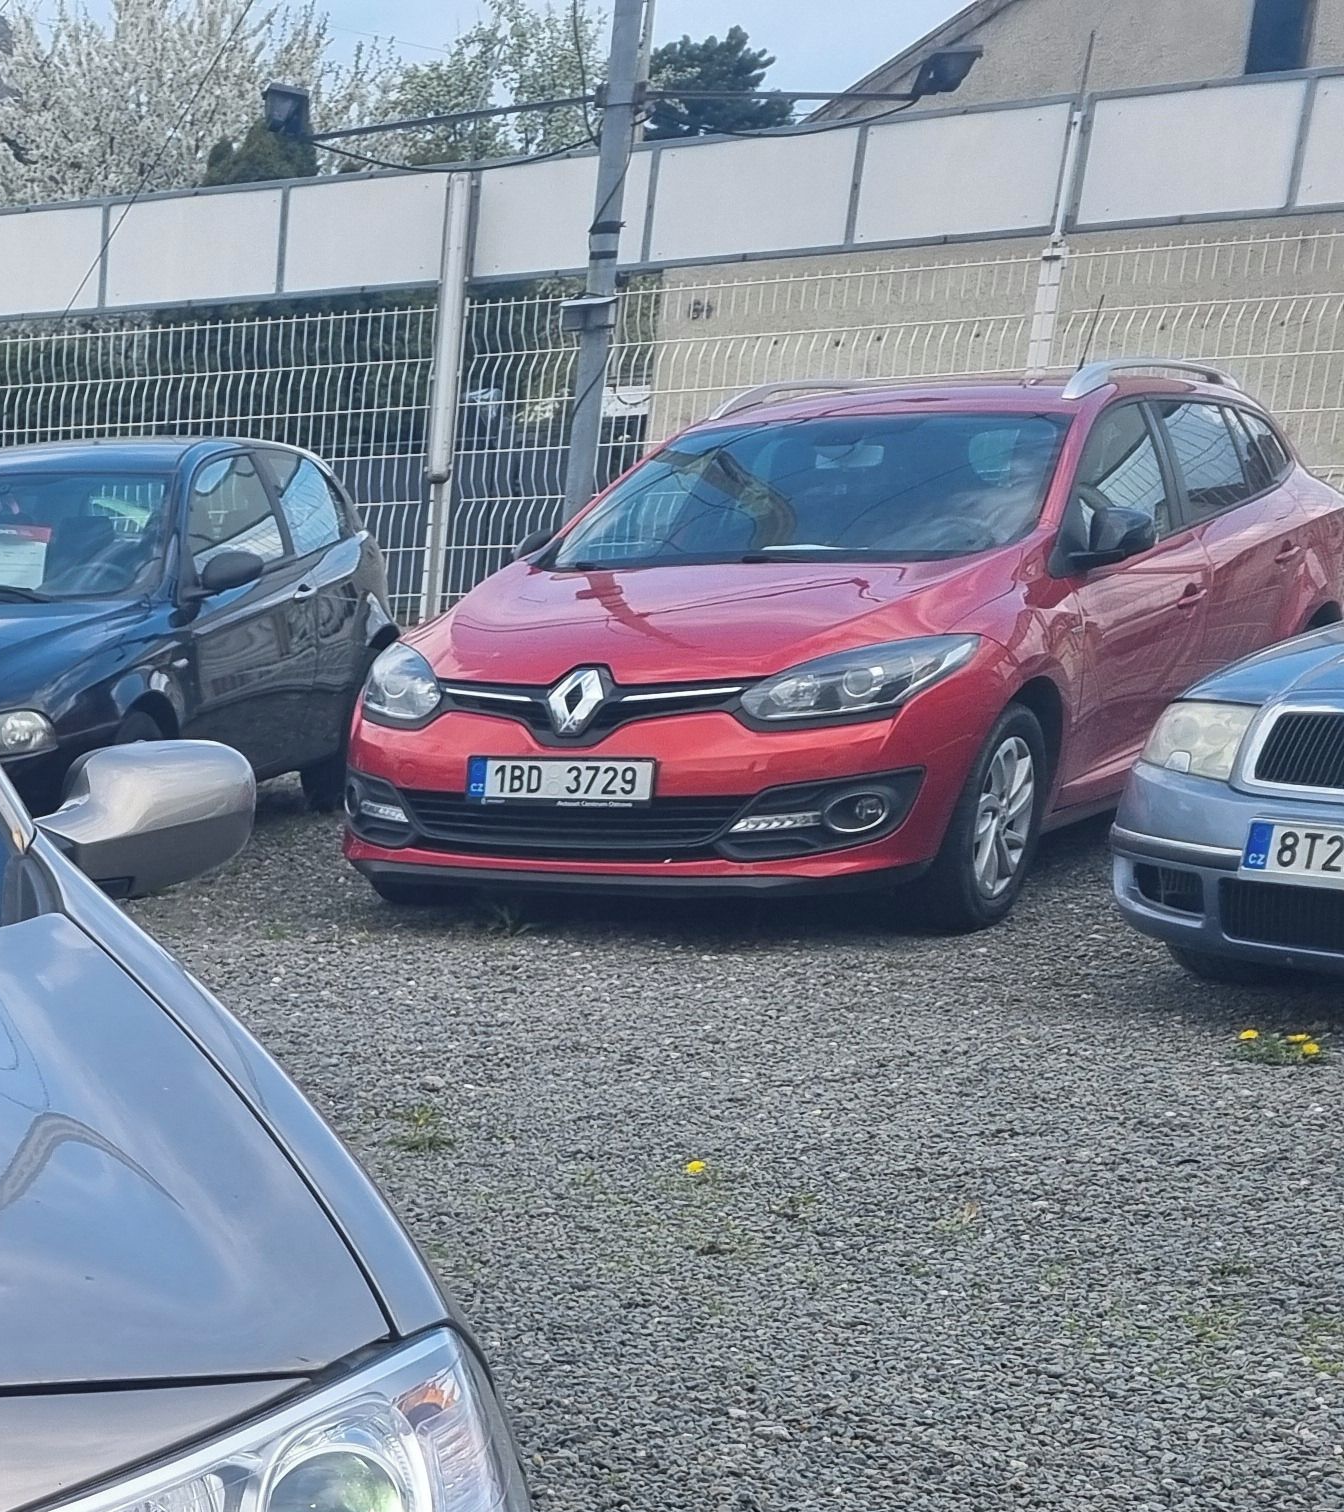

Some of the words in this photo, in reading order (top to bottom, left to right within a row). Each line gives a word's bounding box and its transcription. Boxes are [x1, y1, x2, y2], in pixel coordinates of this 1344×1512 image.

[470, 783, 483, 792] CZ
[495, 764, 542, 793] 1BD
[565, 765, 637, 795] 3729
[1248, 852, 1265, 865] CZ
[1276, 831, 1344, 872] 8T2
